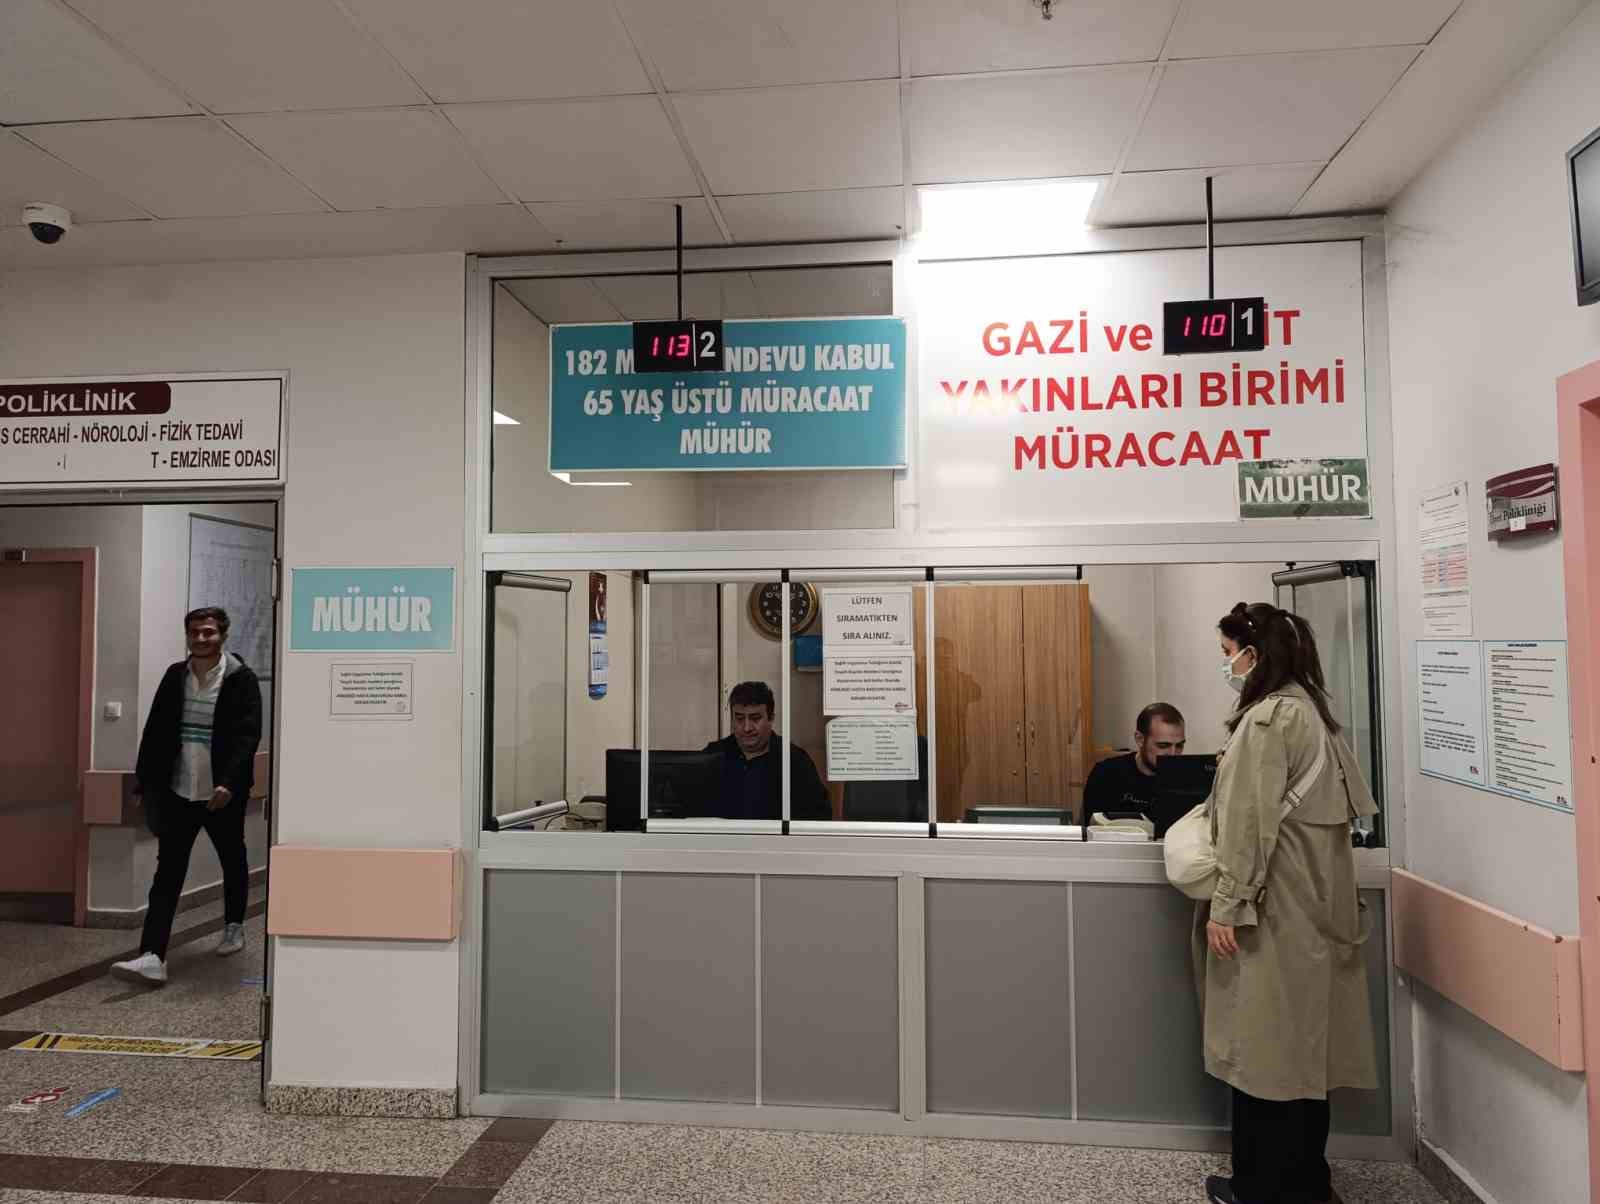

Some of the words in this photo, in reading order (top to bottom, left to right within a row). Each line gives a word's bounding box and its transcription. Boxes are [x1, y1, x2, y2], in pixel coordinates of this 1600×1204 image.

[982, 310, 1089, 357] GAZİ
[1103, 323, 1153, 352] ve
[1183, 313, 1226, 338] 110
[1240, 307, 1255, 336] 1
[651, 334, 691, 357] 113
[699, 331, 716, 358] 2
[565, 349, 607, 375] 182
[724, 346, 810, 374] NDEVU
[814, 344, 895, 371] KABUL
[937, 372, 1182, 413] YAKINLARI
[1199, 358, 1346, 408] BİRİMİ
[583, 390, 613, 416] 65
[620, 388, 664, 422] YAŞ
[671, 380, 731, 415] ÜSTÜ
[740, 380, 873, 414] MÜRACAAT
[0, 427, 9, 445] S
[12, 421, 71, 444] CERRAHİ
[81, 420, 149, 443] NÖROLOJİ
[159, 419, 193, 442] FİZİK
[195, 418, 244, 441] TEDAVİ
[680, 420, 772, 455] MÜHÜR
[170, 447, 231, 468] EMZİRME
[234, 448, 276, 467] ODASI
[1013, 426, 1271, 471] MÜRACAAT
[312, 585, 432, 633] MÜHÜR
[851, 595, 883, 606] LÜTFEN
[842, 631, 862, 641] SIRA
